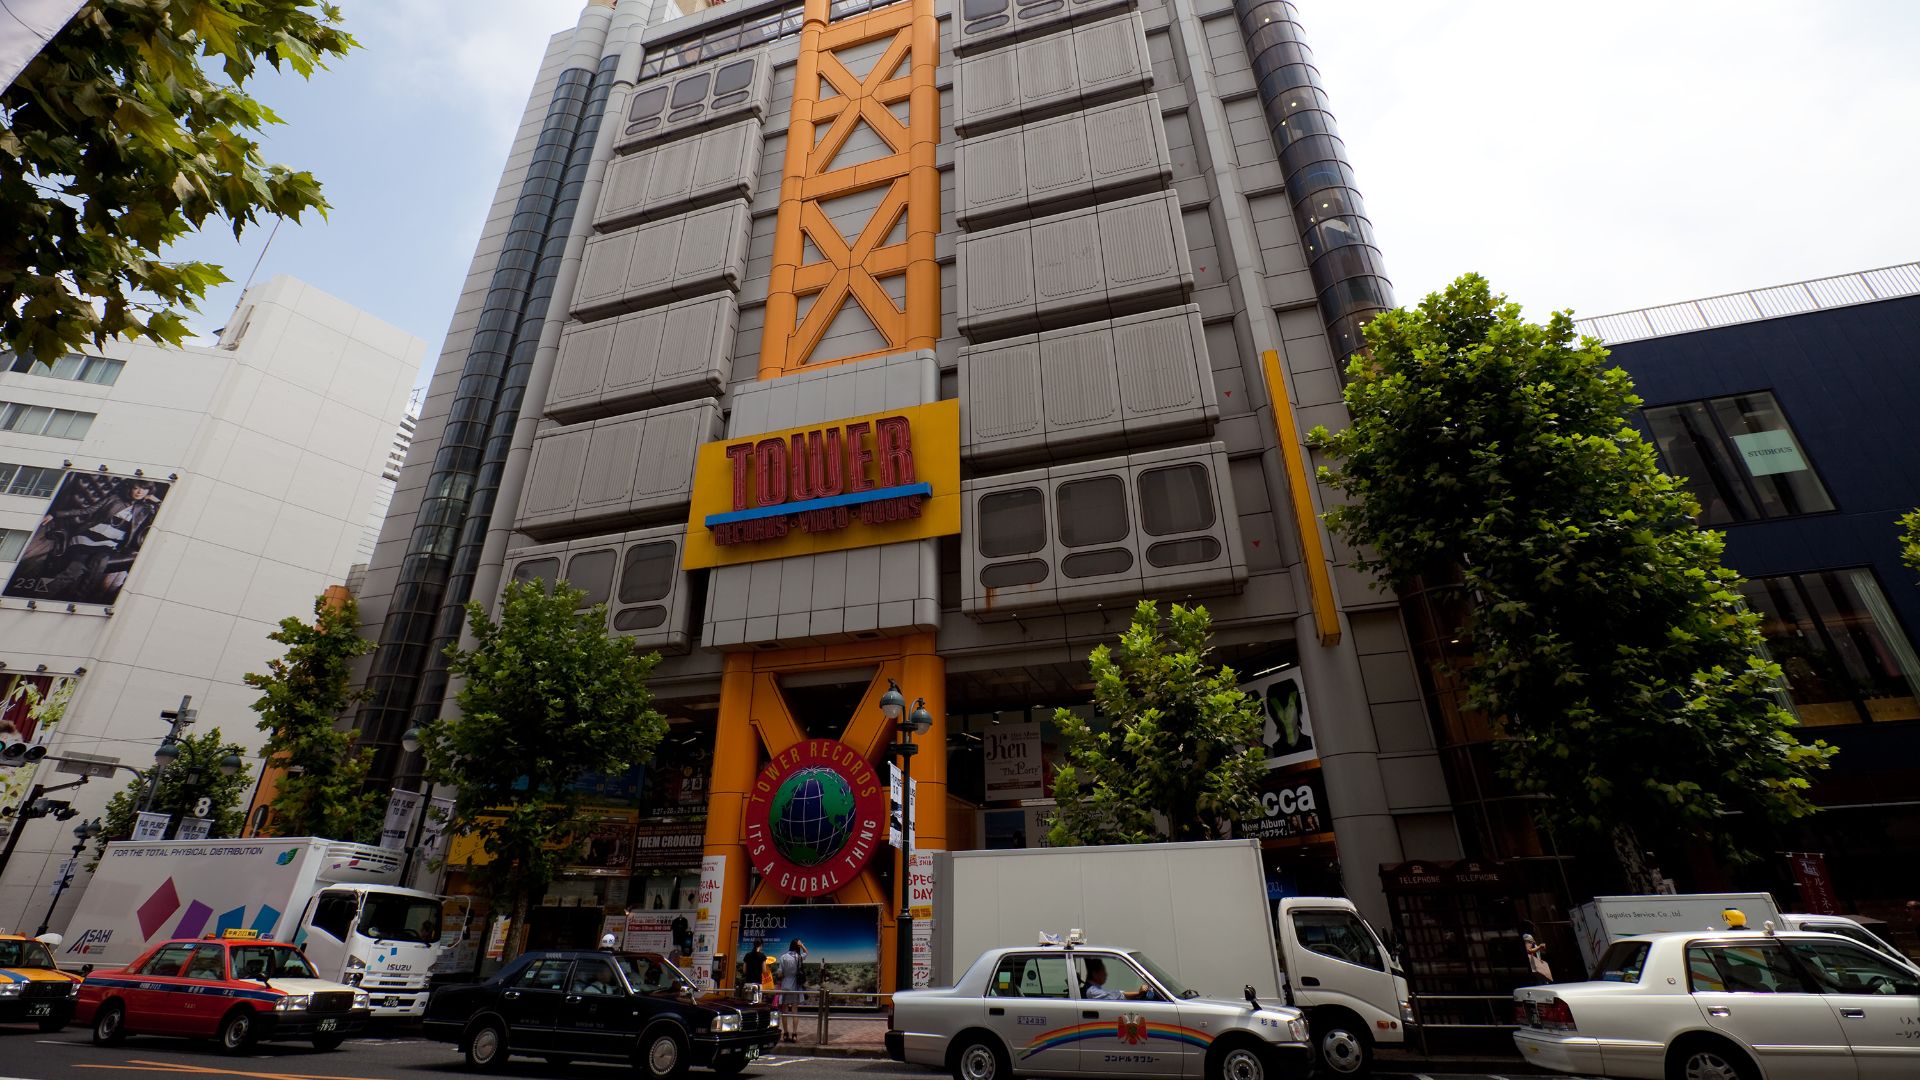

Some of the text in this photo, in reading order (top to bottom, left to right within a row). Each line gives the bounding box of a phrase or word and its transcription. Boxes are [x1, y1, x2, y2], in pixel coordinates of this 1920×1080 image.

[1748, 446, 1793, 457] STUDIOUS
[726, 415, 916, 511] TOWER
[714, 495, 922, 547] RECORDS VIDEO BOOKS
[751, 742, 876, 803] TOWER RECORDS
[194, 797, 212, 817] 8
[1256, 785, 1317, 817] cca
[1261, 819, 1286, 829] Album
[637, 835, 701, 848] THEM CROOKED
[113, 849, 128, 857] FOR
[171, 848, 207, 856] PHYSICAL
[209, 847, 264, 855] DISTRIBUTION
[749, 819, 876, 892] IT'S A GLOBAL THING
[1399, 873, 1500, 885] TELEPHONE TELEPHONE
[744, 913, 787, 929] Hadou
[66, 929, 114, 954] ASAHI
[387, 963, 412, 971] ISUZU
